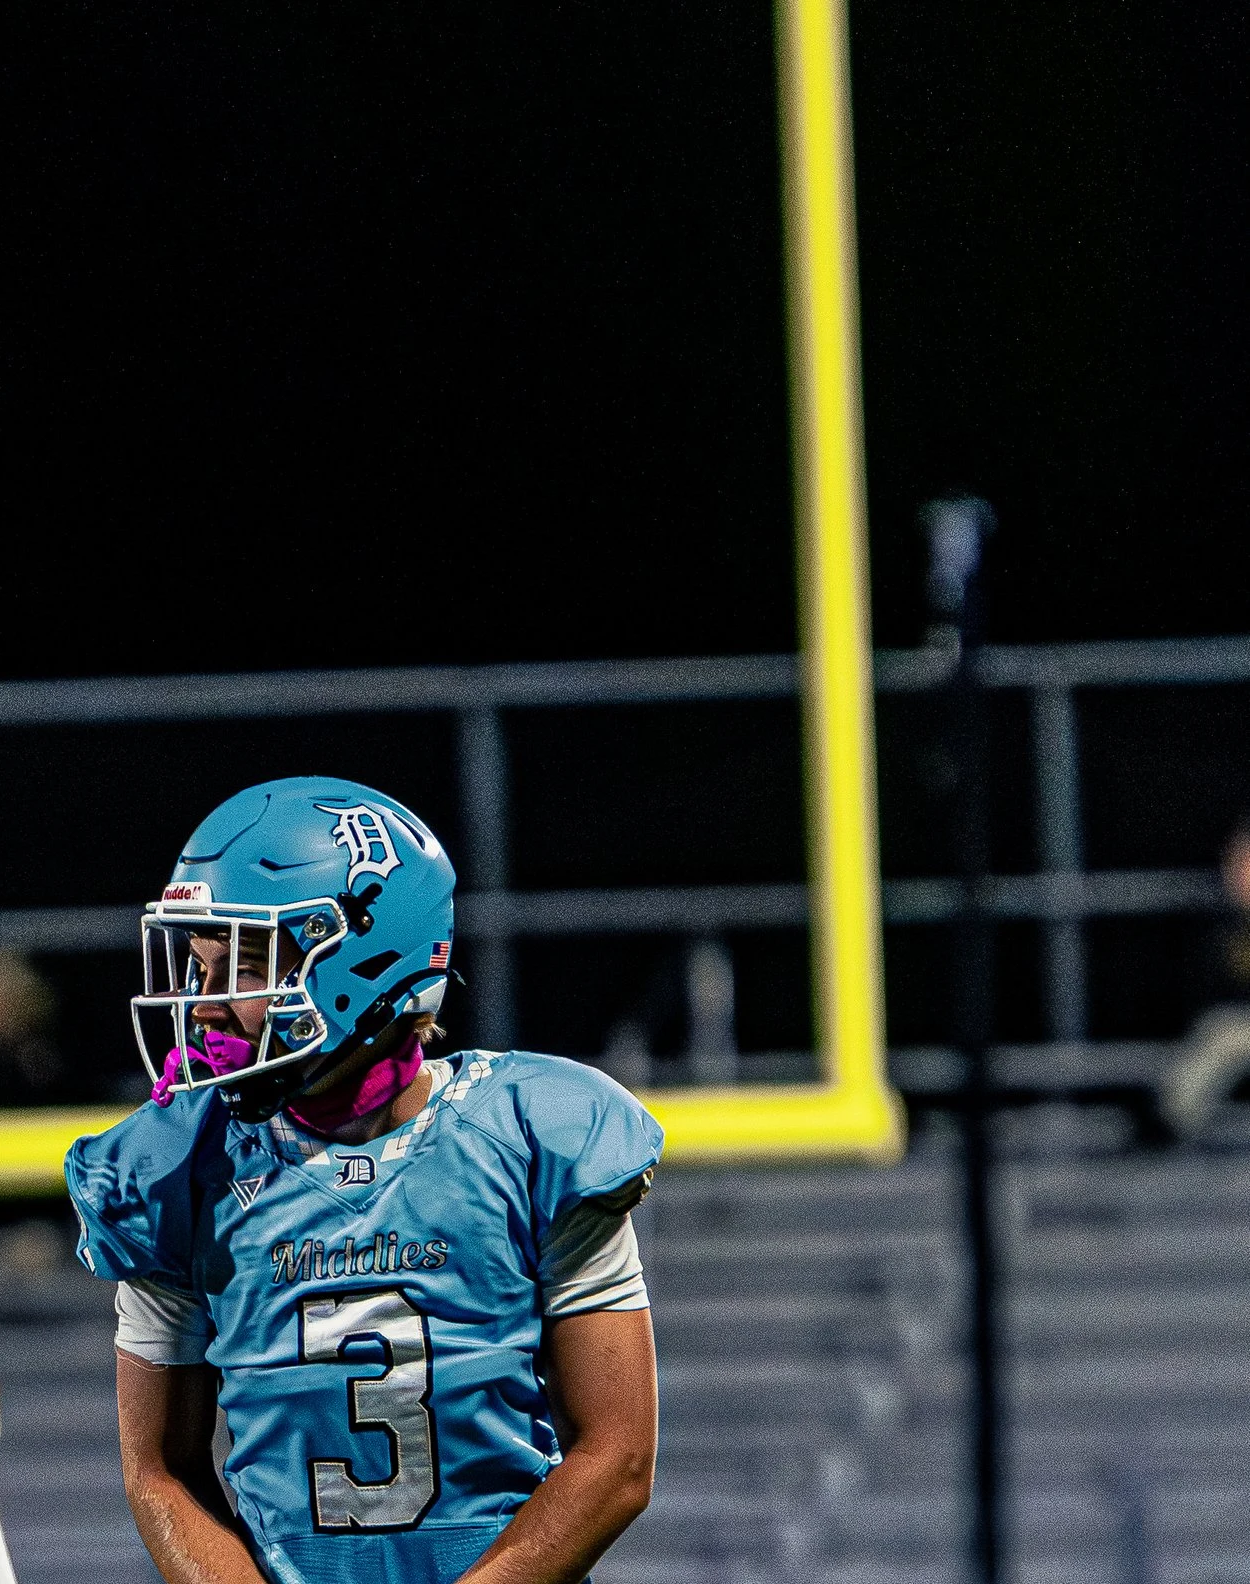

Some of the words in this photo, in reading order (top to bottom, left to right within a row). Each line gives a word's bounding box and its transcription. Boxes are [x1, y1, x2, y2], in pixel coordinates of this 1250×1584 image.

[313, 804, 404, 893] D
[333, 1153, 376, 1189] D
[272, 1231, 448, 1284] Middies
[298, 1287, 441, 1534] 3
